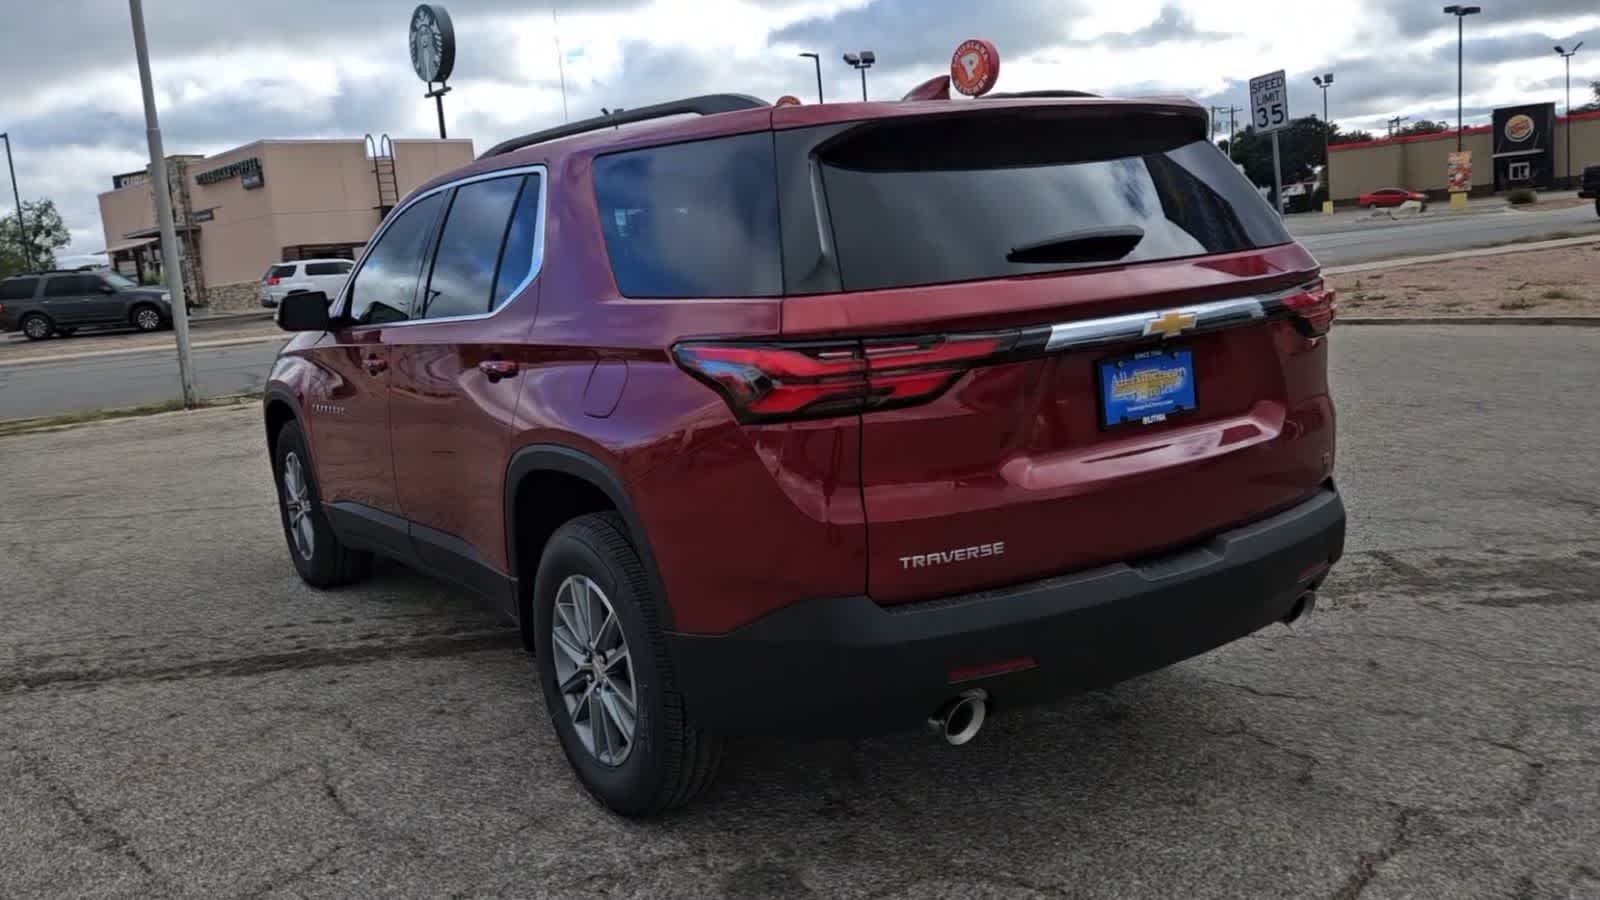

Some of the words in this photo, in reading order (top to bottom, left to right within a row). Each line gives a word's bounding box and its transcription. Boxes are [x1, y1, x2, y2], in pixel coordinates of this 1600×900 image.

[1251, 77, 1284, 94] SPEED
[1256, 90, 1280, 106] LIMIT
[1257, 103, 1284, 128] 35
[899, 541, 1005, 569] TRAVERSE
